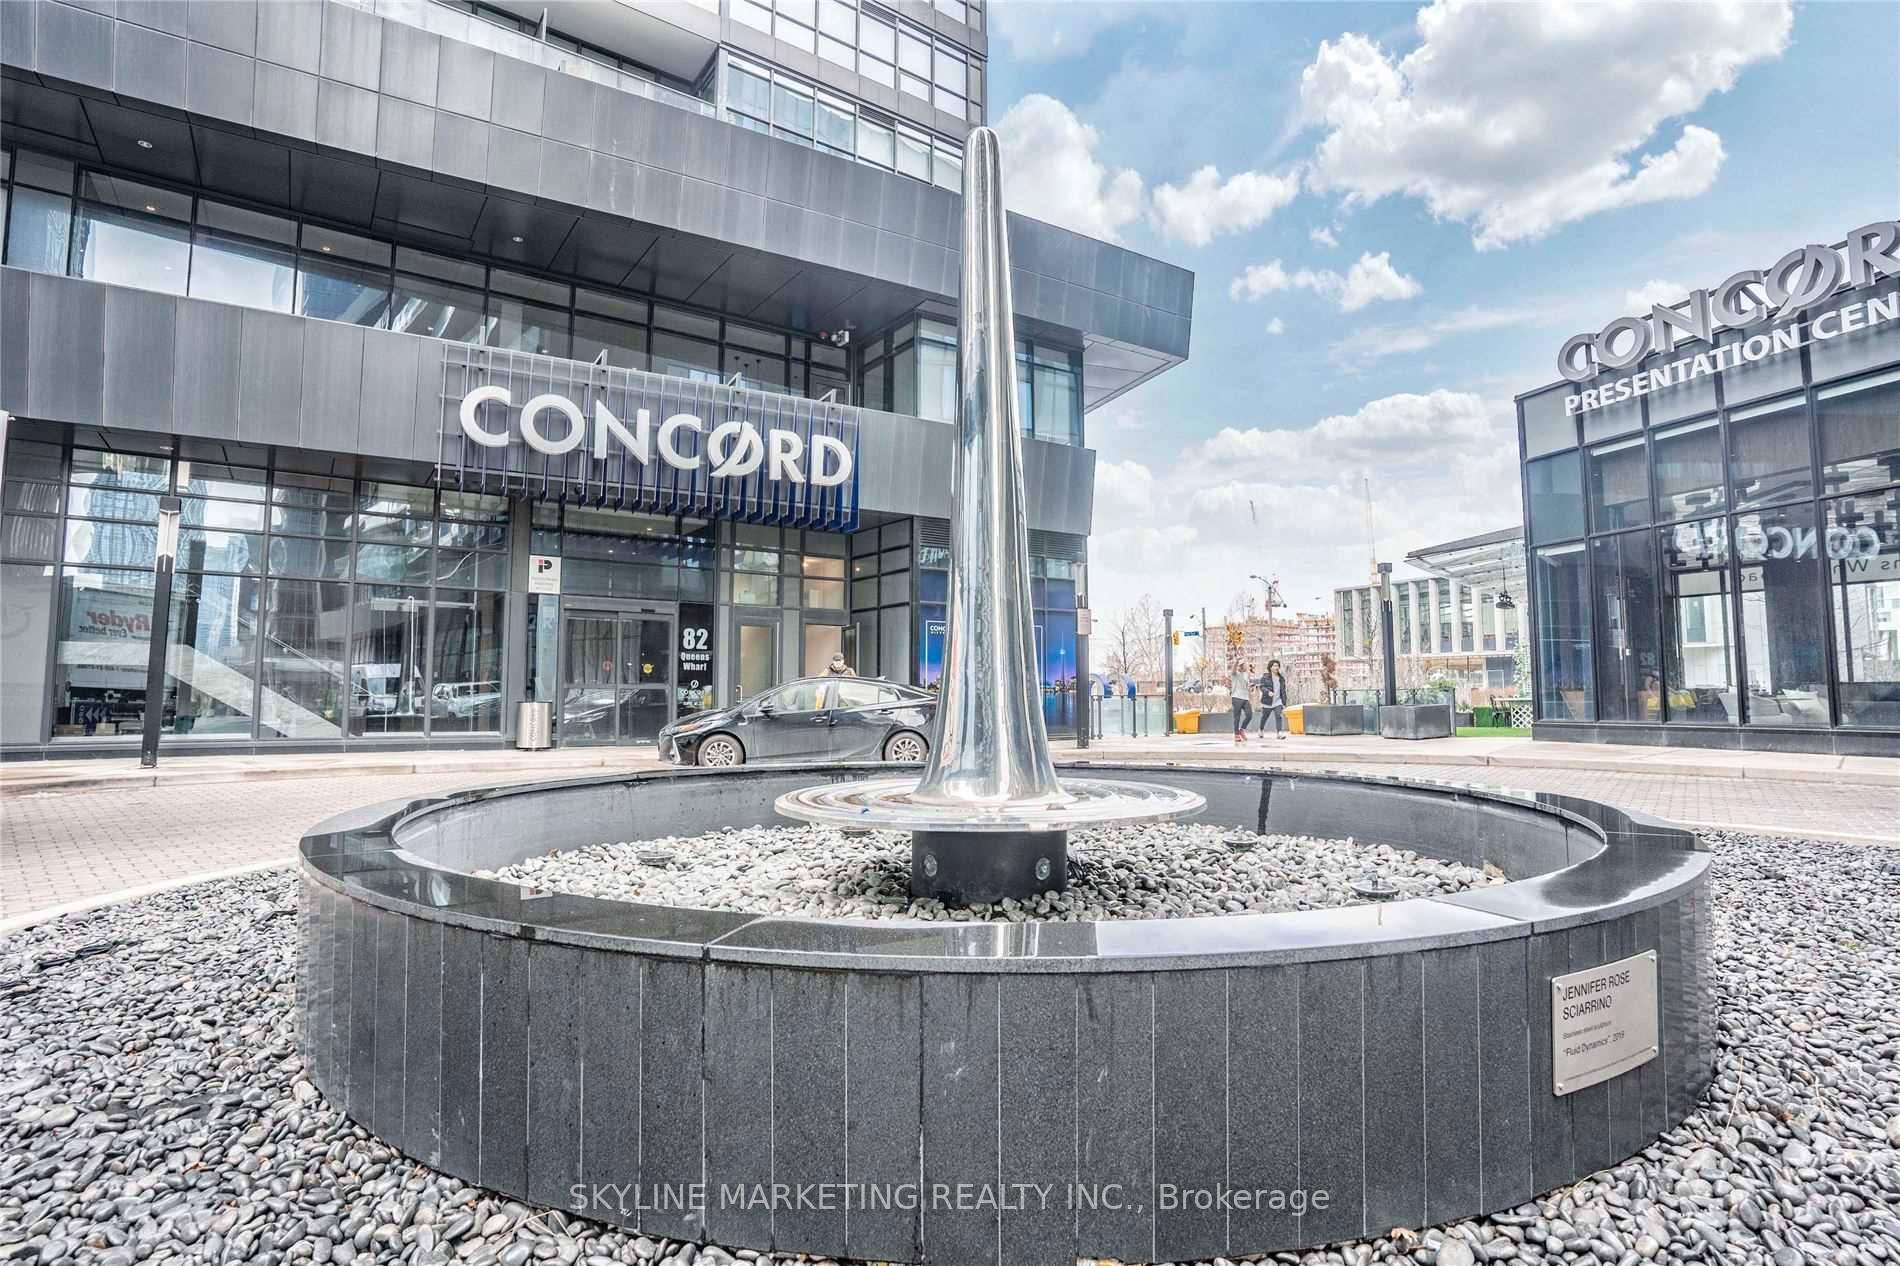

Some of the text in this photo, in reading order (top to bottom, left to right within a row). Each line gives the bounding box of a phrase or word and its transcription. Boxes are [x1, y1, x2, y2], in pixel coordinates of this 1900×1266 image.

[1565, 323, 1802, 417] PRESENTATION
[683, 627, 708, 650] 82
[680, 652, 710, 661] Queens
[683, 662, 707, 671] Wharf
[1562, 970, 1631, 1001] JENNIFER ROSE
[1562, 995, 1613, 1020] SCIARRINO
